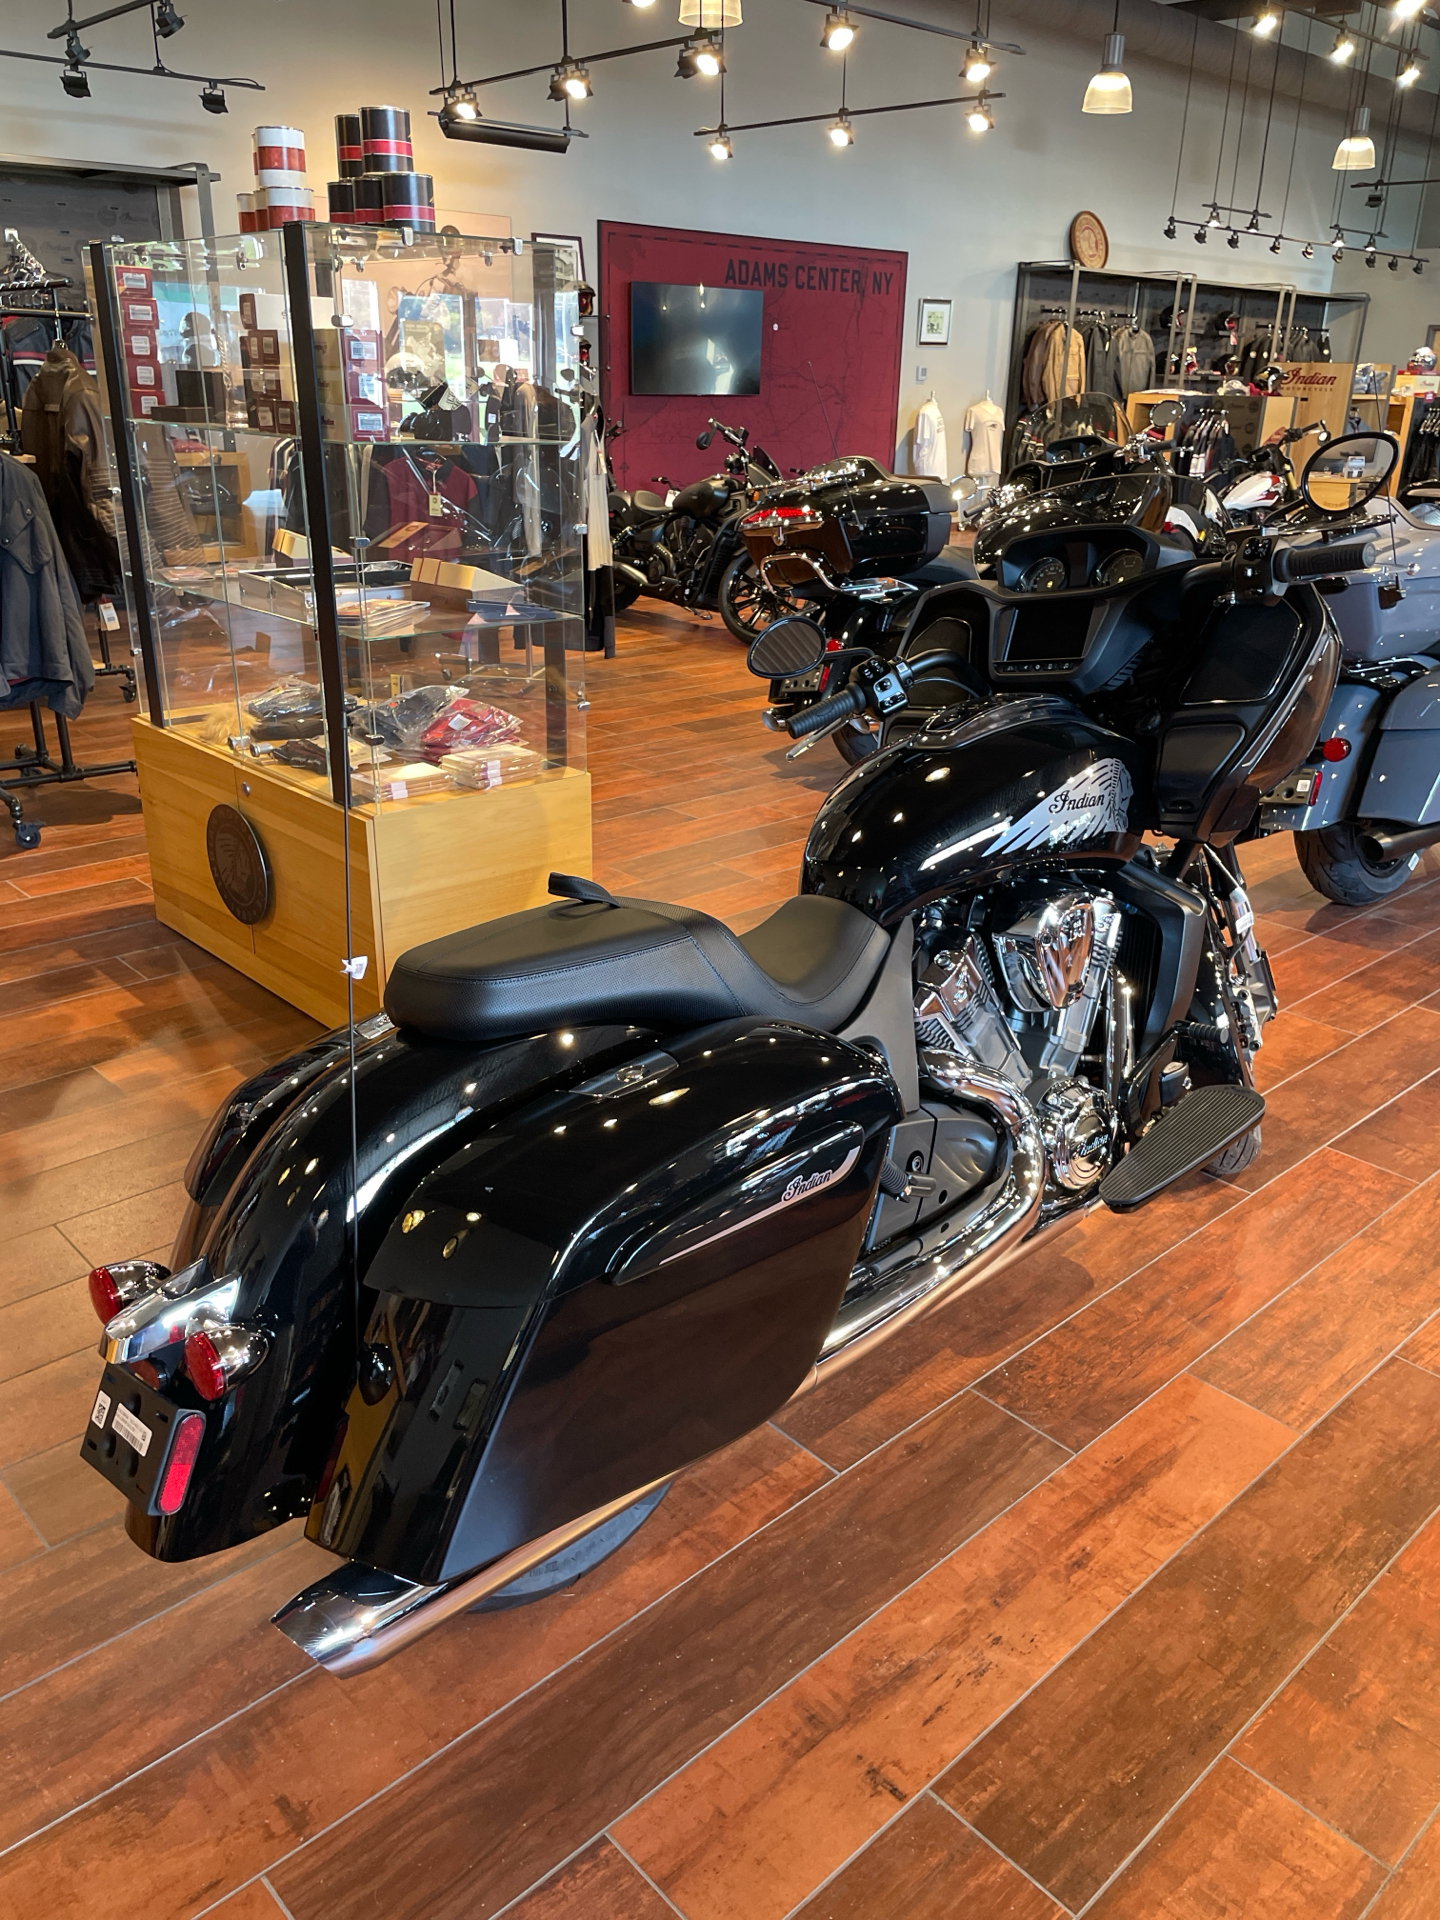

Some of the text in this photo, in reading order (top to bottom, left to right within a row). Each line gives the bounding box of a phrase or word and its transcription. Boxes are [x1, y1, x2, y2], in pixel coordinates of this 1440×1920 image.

[724, 258, 789, 288] ADAMS
[871, 271, 894, 296] NY
[1281, 366, 1338, 386] Indian
[1048, 789, 1105, 814] Indian
[782, 1170, 832, 1202] Indian
